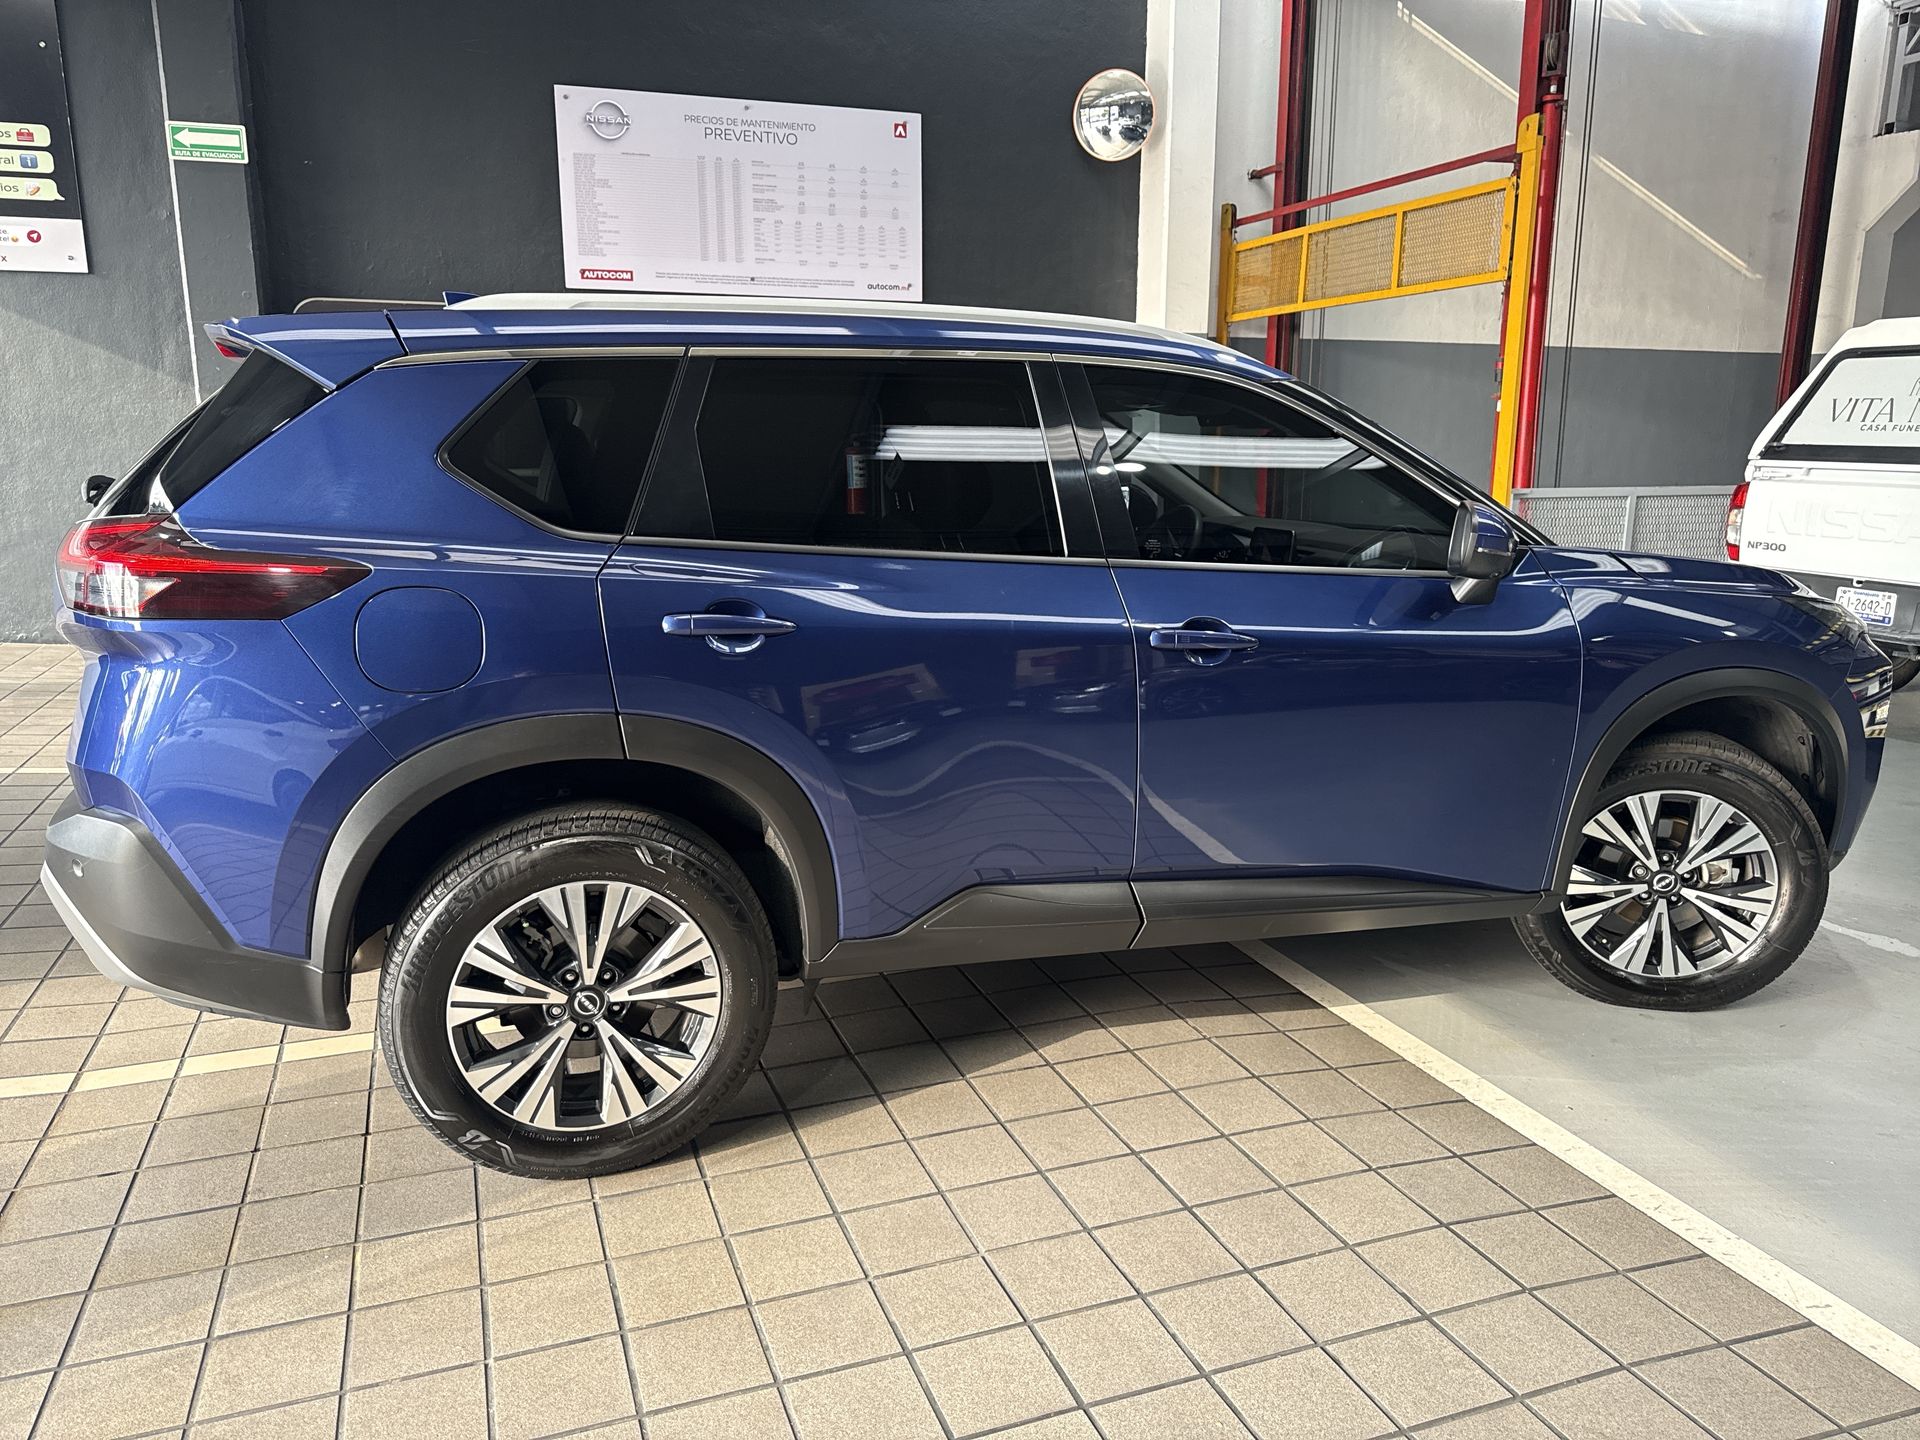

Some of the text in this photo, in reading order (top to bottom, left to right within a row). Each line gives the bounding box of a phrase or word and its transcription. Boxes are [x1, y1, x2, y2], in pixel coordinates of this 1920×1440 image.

[586, 114, 632, 125] NISSAN
[684, 114, 817, 132] PRECIOS DE MANTENIMIENTO
[704, 126, 798, 146] PREVENTIVO
[583, 270, 632, 280] AUTOCOM
[1832, 397, 1895, 422] VITA
[1860, 424, 1887, 432] CASA
[1747, 540, 1787, 552] NP300
